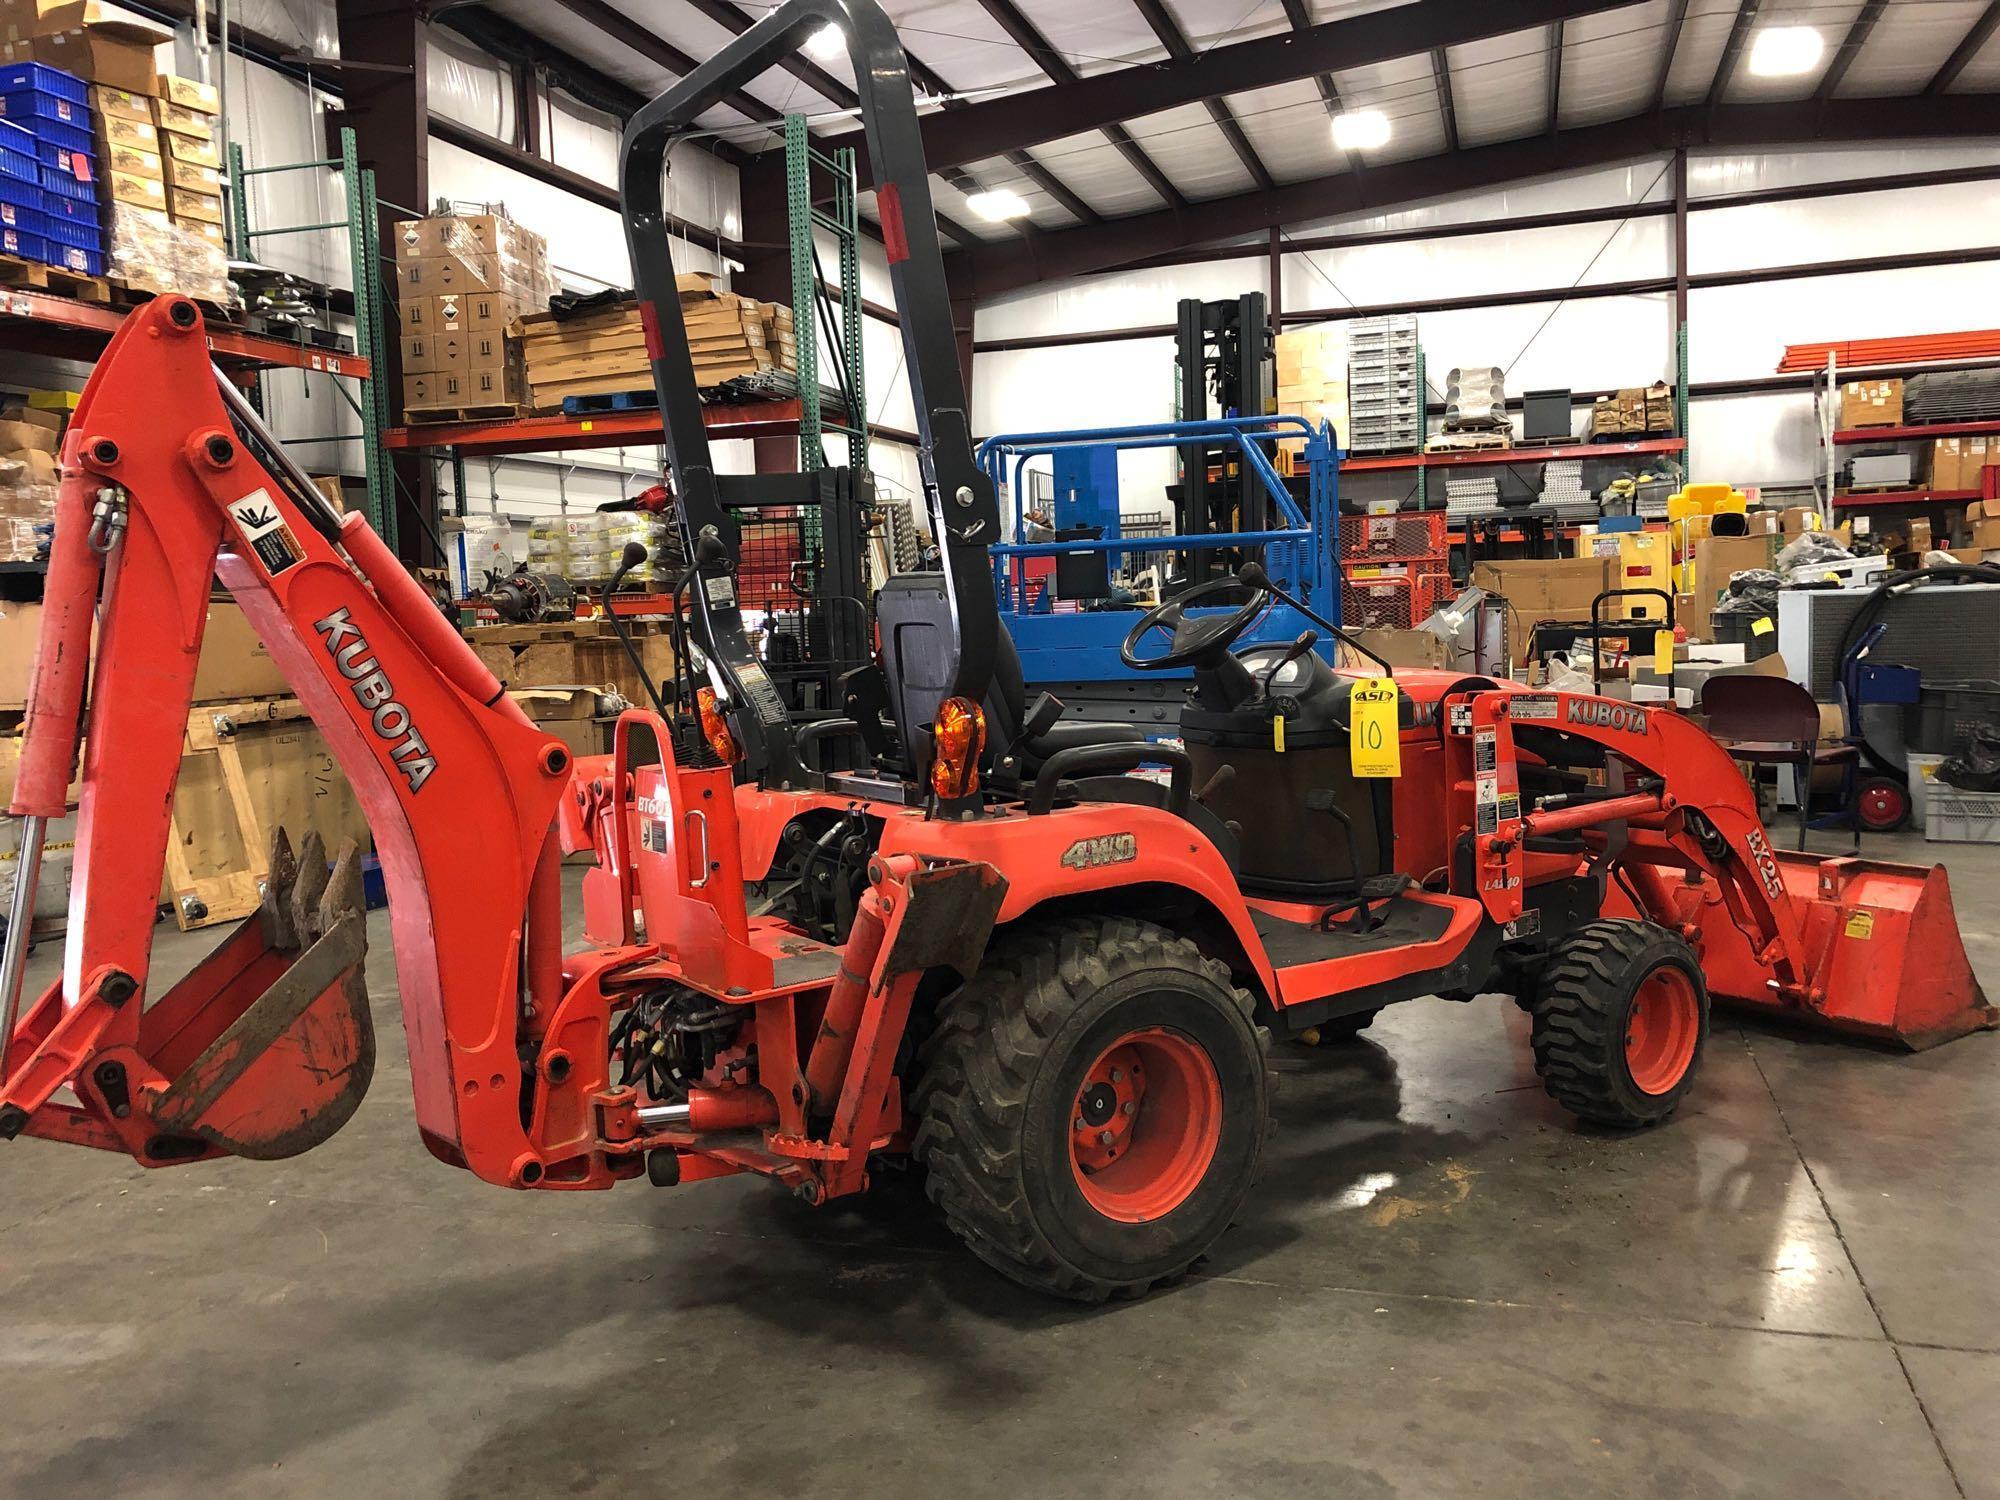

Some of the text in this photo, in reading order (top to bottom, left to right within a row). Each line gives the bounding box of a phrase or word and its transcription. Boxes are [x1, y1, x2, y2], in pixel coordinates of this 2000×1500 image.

[282, 531, 302, 560] WARNING
[314, 607, 439, 794] KUBOTA
[1567, 698, 1648, 735] KUBOTA
[1360, 720, 1382, 750] 10
[1061, 831, 1138, 871] 4WD
[1745, 827, 1783, 899] BX25
